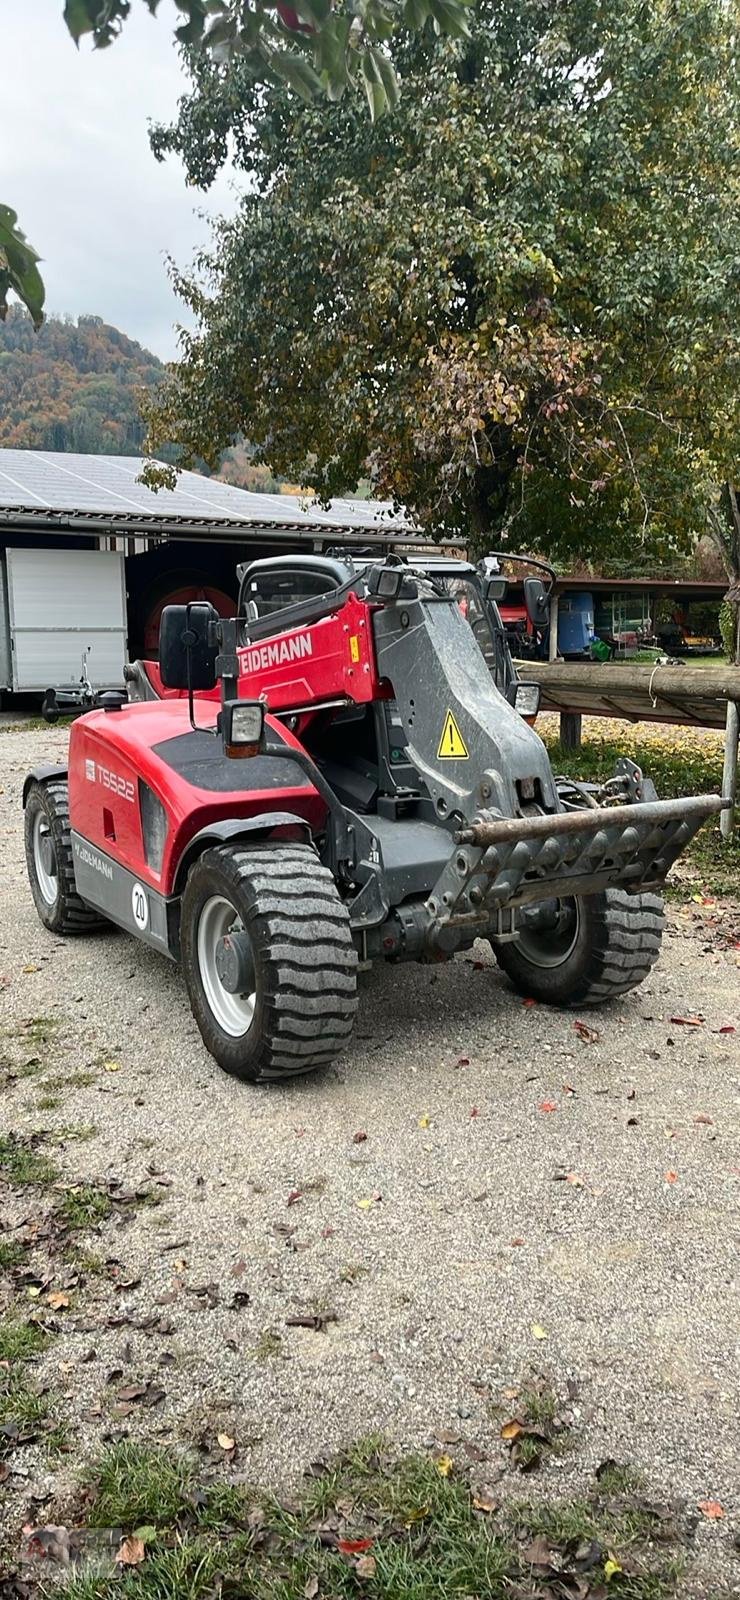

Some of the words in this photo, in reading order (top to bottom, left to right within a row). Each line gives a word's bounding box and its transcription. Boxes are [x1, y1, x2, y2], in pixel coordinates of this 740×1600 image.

[238, 632, 313, 675] EIDEMANN
[97, 764, 135, 803] TS522
[134, 890, 145, 922] 20
